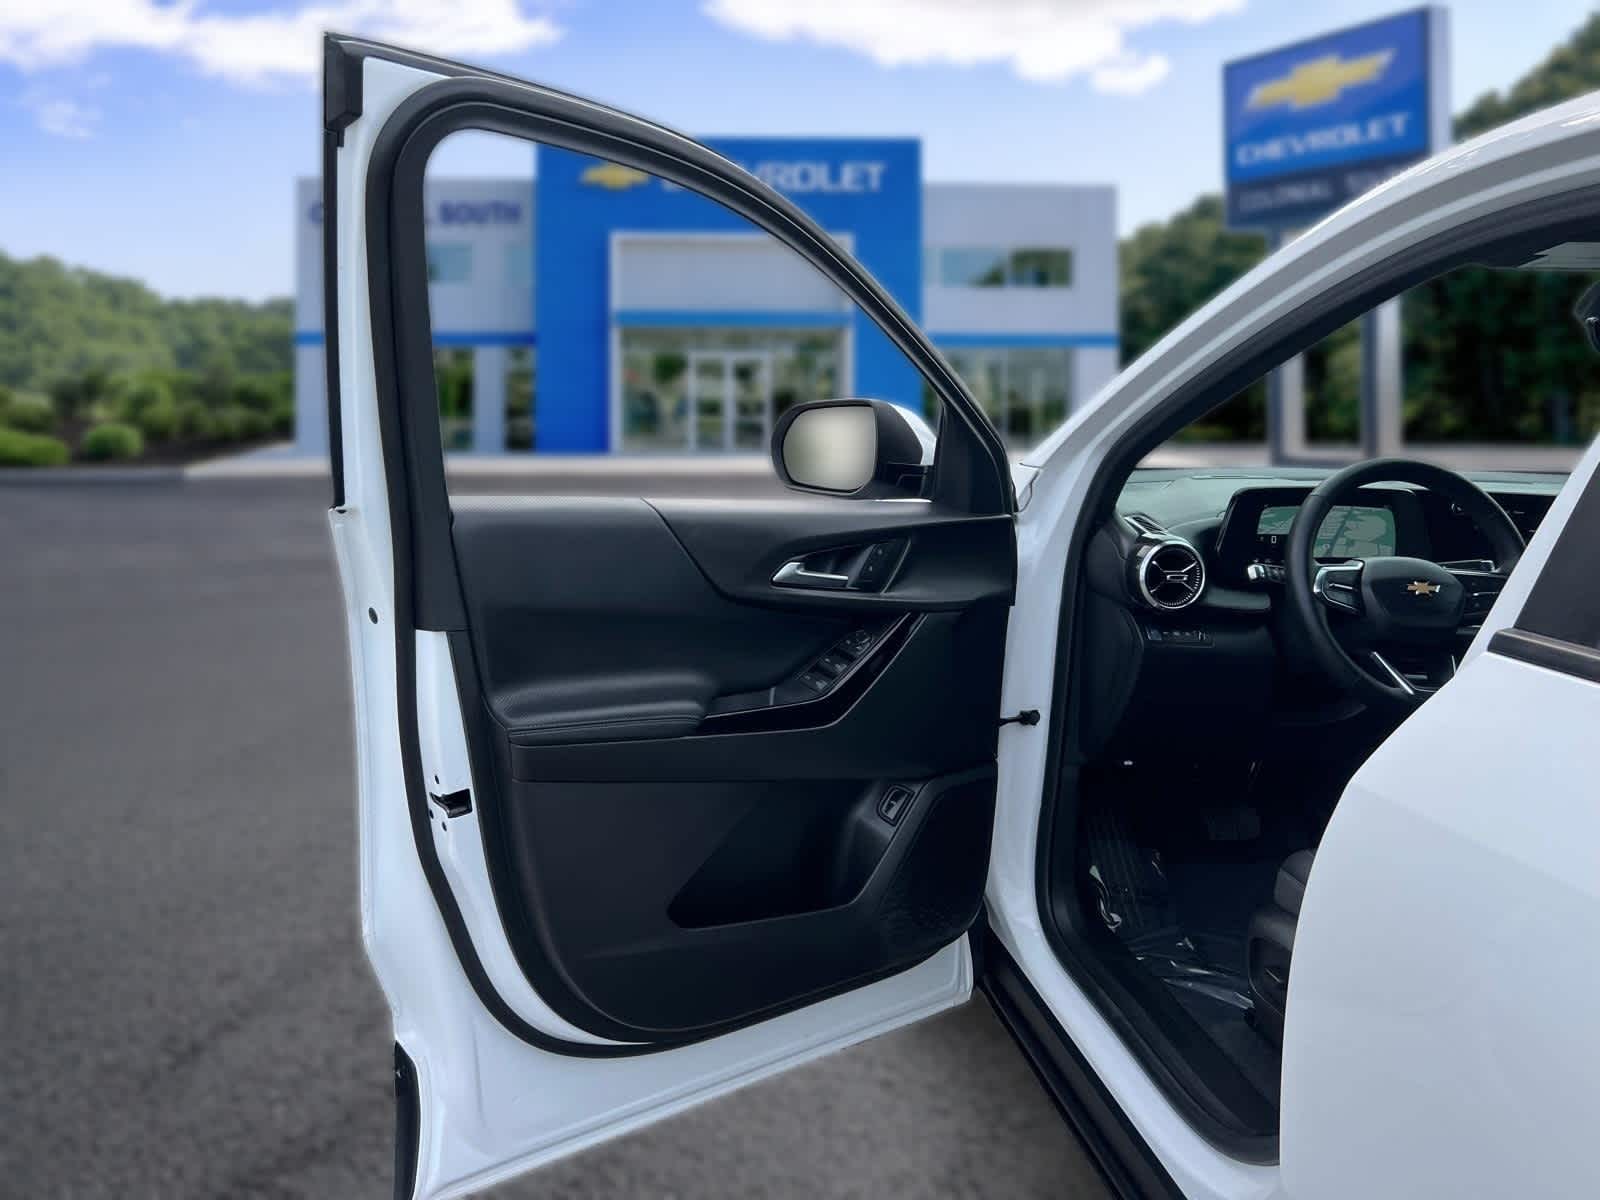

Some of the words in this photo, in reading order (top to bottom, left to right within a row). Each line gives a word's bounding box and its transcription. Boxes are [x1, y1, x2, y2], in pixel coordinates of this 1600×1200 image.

[1236, 112, 1409, 167] CHEVROLET
[660, 161, 885, 192] ROLET
[439, 202, 523, 225] SOUTH
